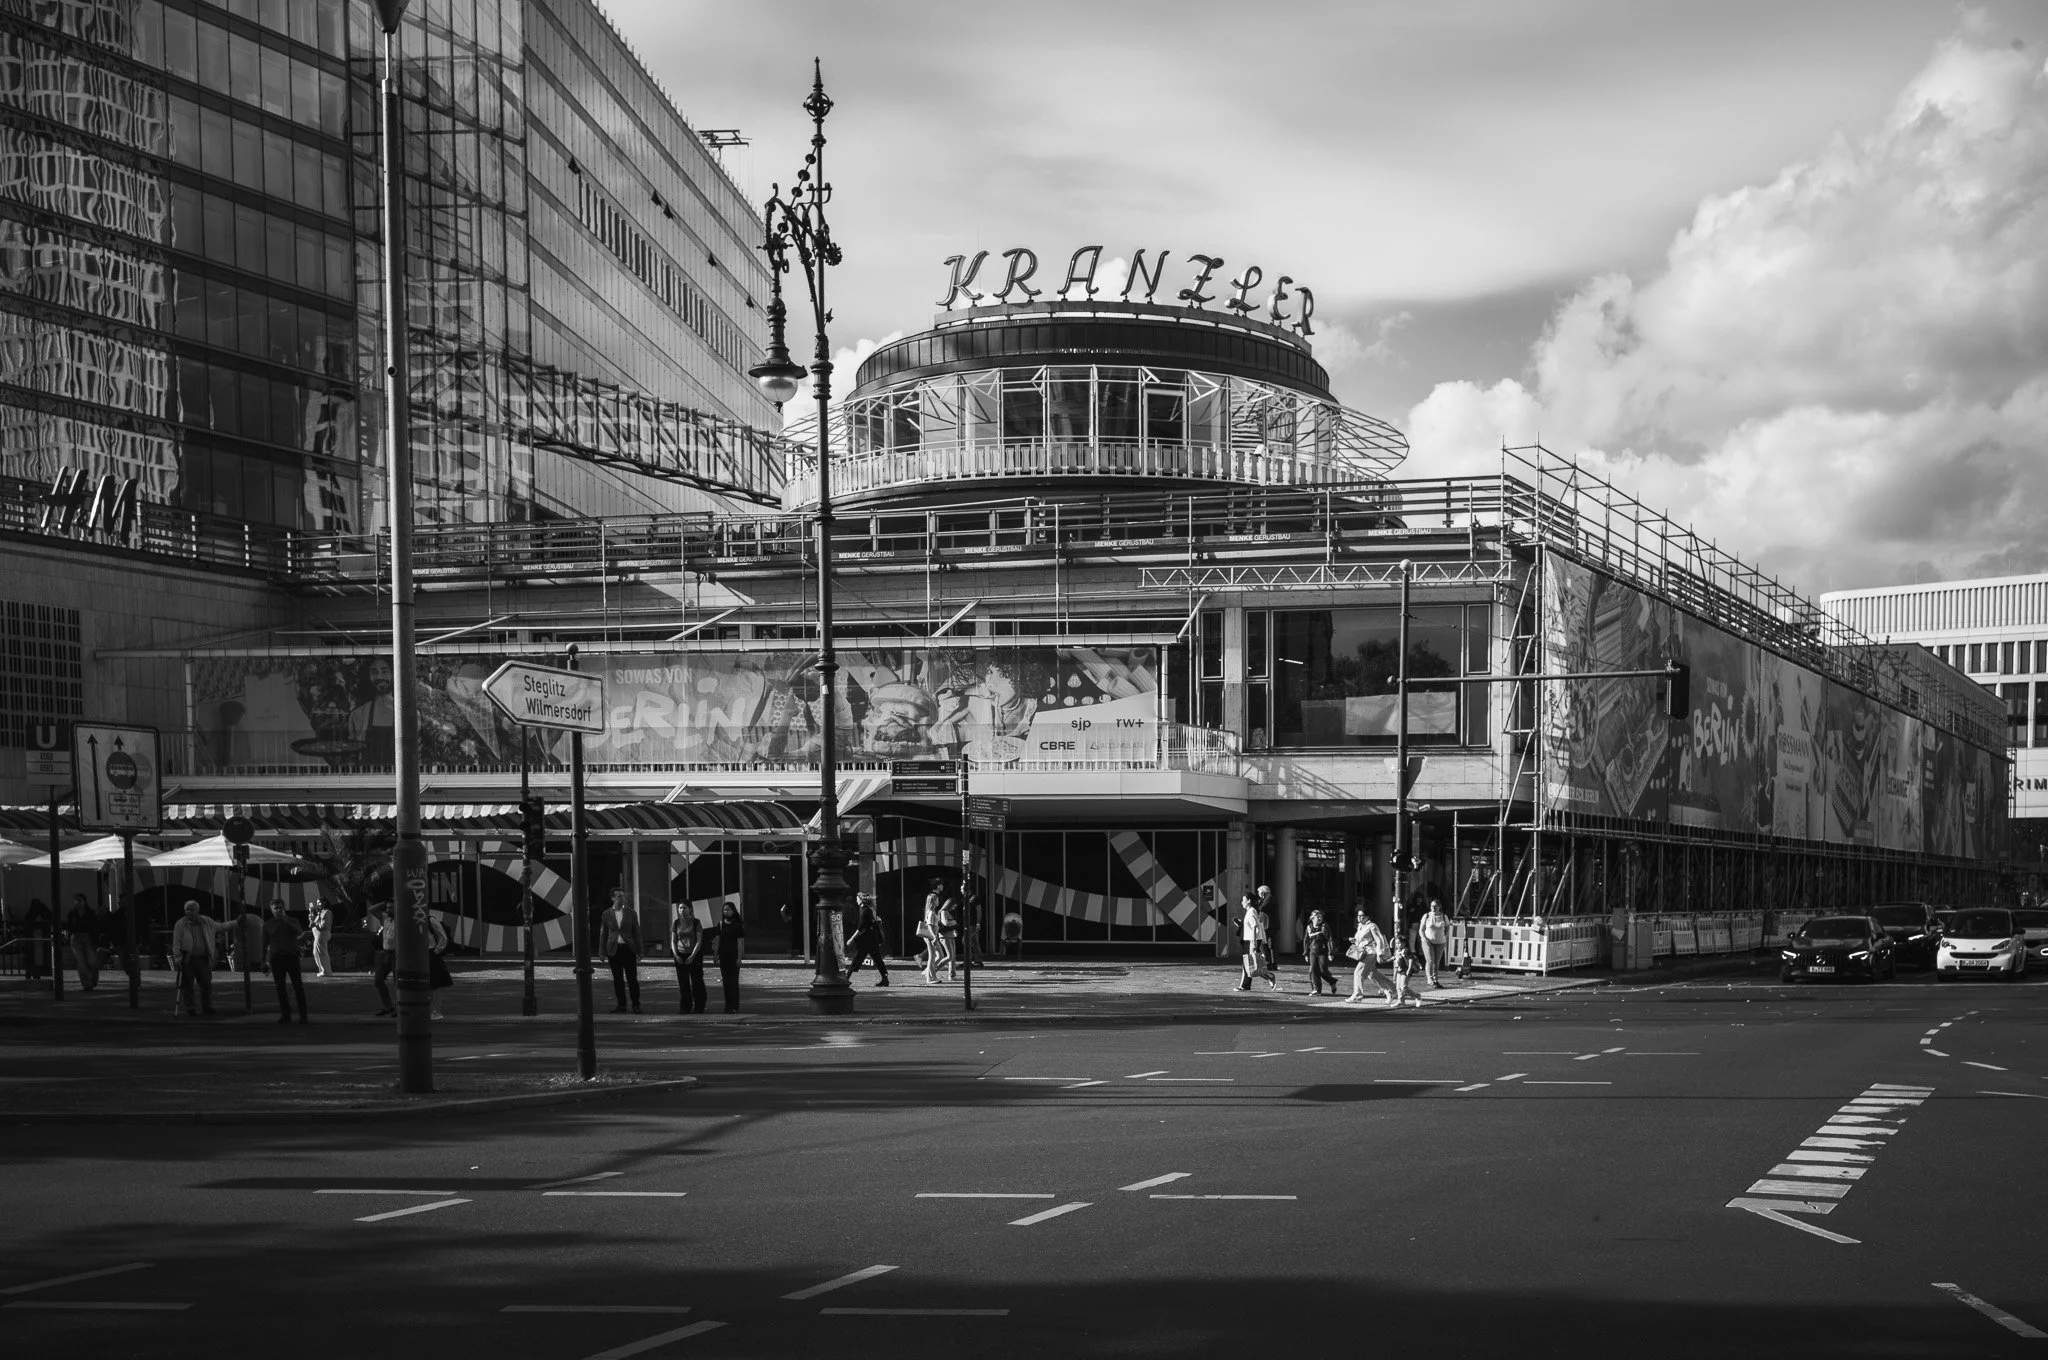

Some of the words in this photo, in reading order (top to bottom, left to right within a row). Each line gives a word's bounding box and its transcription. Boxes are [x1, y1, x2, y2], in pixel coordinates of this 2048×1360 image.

[936, 245, 1315, 335] KRANZLER
[524, 674, 566, 699] Steglitz
[615, 668, 662, 685] SOWAS
[665, 667, 693, 684] VON
[525, 697, 591, 722] Wilmersdorf
[1071, 717, 1092, 731] sjp
[1116, 718, 1145, 728] rw+
[36, 725, 57, 749] U
[1040, 741, 1075, 750] CBRE
